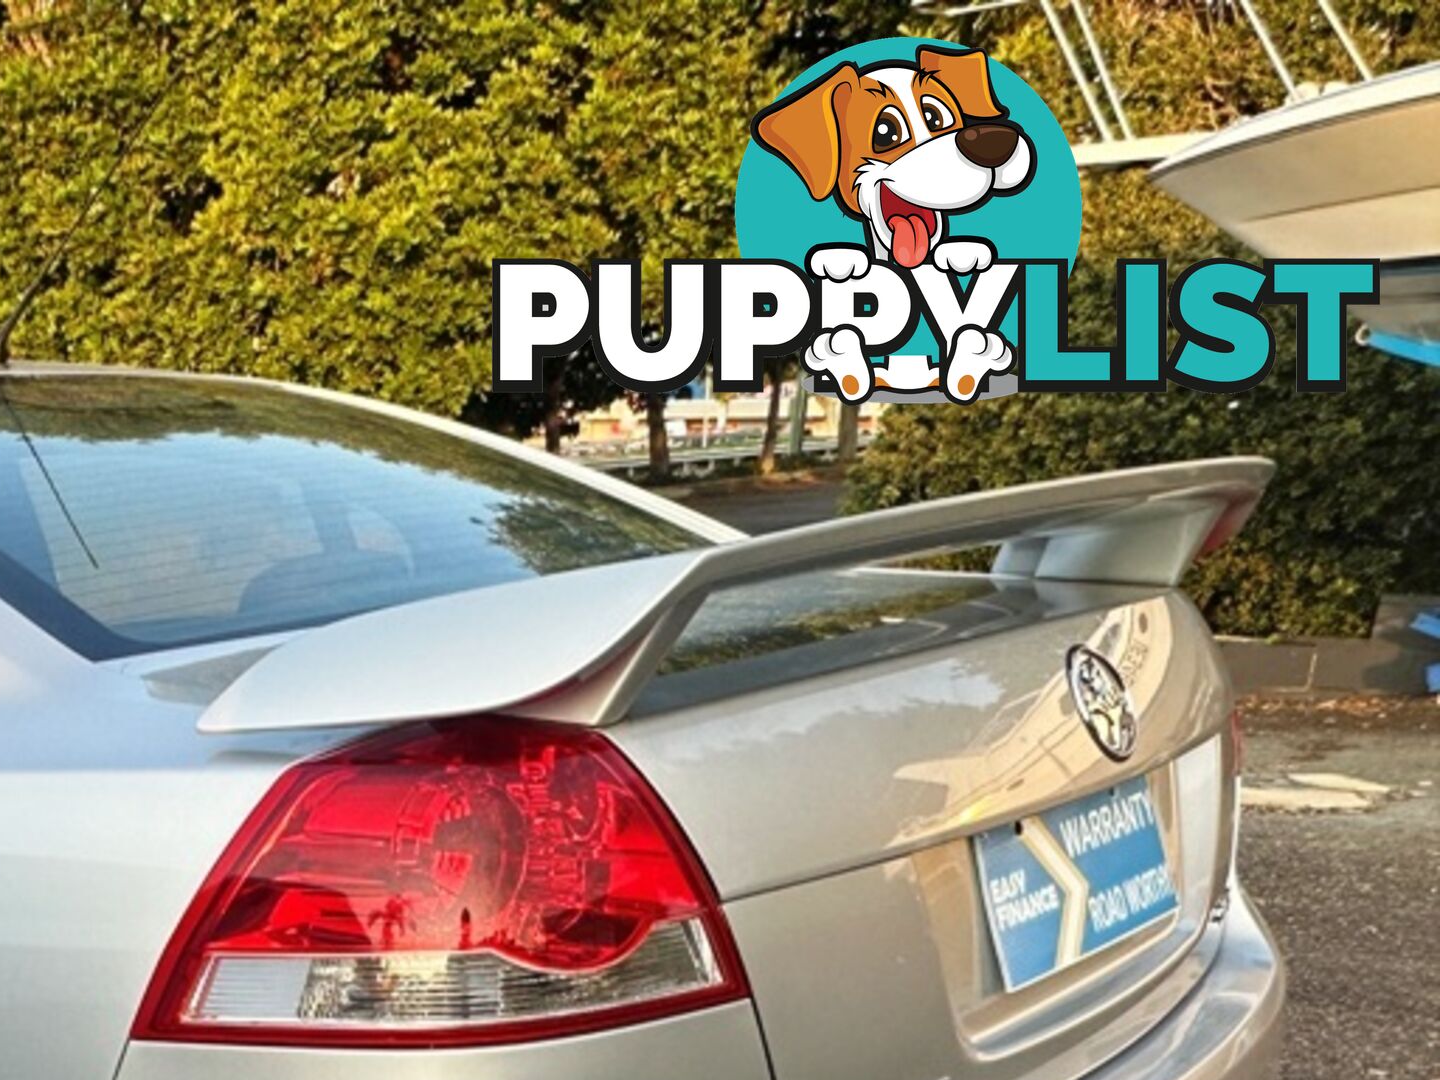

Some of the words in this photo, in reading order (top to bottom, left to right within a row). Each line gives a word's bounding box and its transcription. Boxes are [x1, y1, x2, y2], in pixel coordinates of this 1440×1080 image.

[1059, 790, 1155, 858] WARRANTY
[990, 869, 1027, 902] EASY
[995, 884, 1059, 931] FINANCE
[1088, 886, 1128, 932] ROAD
